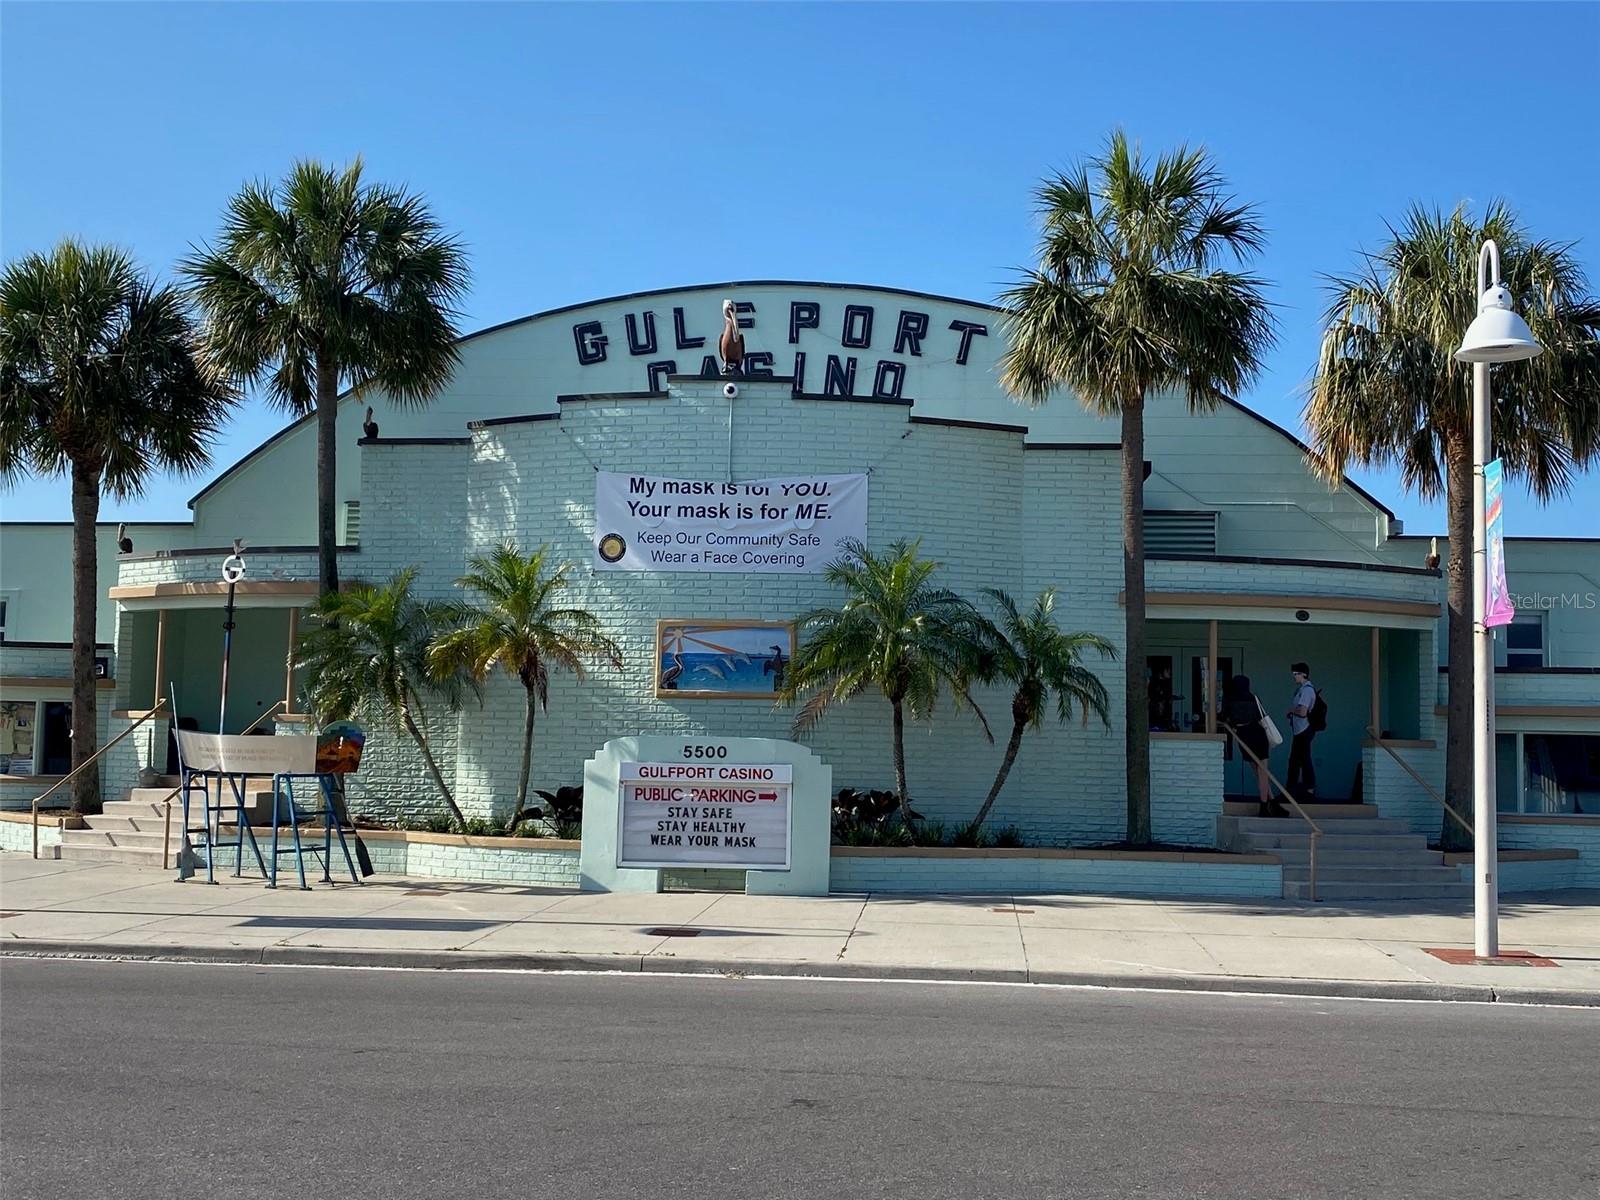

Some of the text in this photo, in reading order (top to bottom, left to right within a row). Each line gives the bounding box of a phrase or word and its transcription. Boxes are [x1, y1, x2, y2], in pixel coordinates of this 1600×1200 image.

[629, 478, 657, 497] My
[663, 480, 715, 495] mask
[781, 482, 832, 496] YOU.
[627, 501, 832, 519] Your mask is for ME.
[637, 532, 820, 549] Keep Our Community Safe
[651, 551, 805, 567] Wear a Face Covering
[683, 746, 728, 758] 5500
[639, 766, 774, 780] GULFPORT CASINO
[634, 788, 757, 803] PUBLIC PARKING
[668, 807, 733, 819] STAY SAFE
[657, 821, 747, 833] STAY HEALTHY
[650, 834, 756, 848] WEAR YOUR MASK
